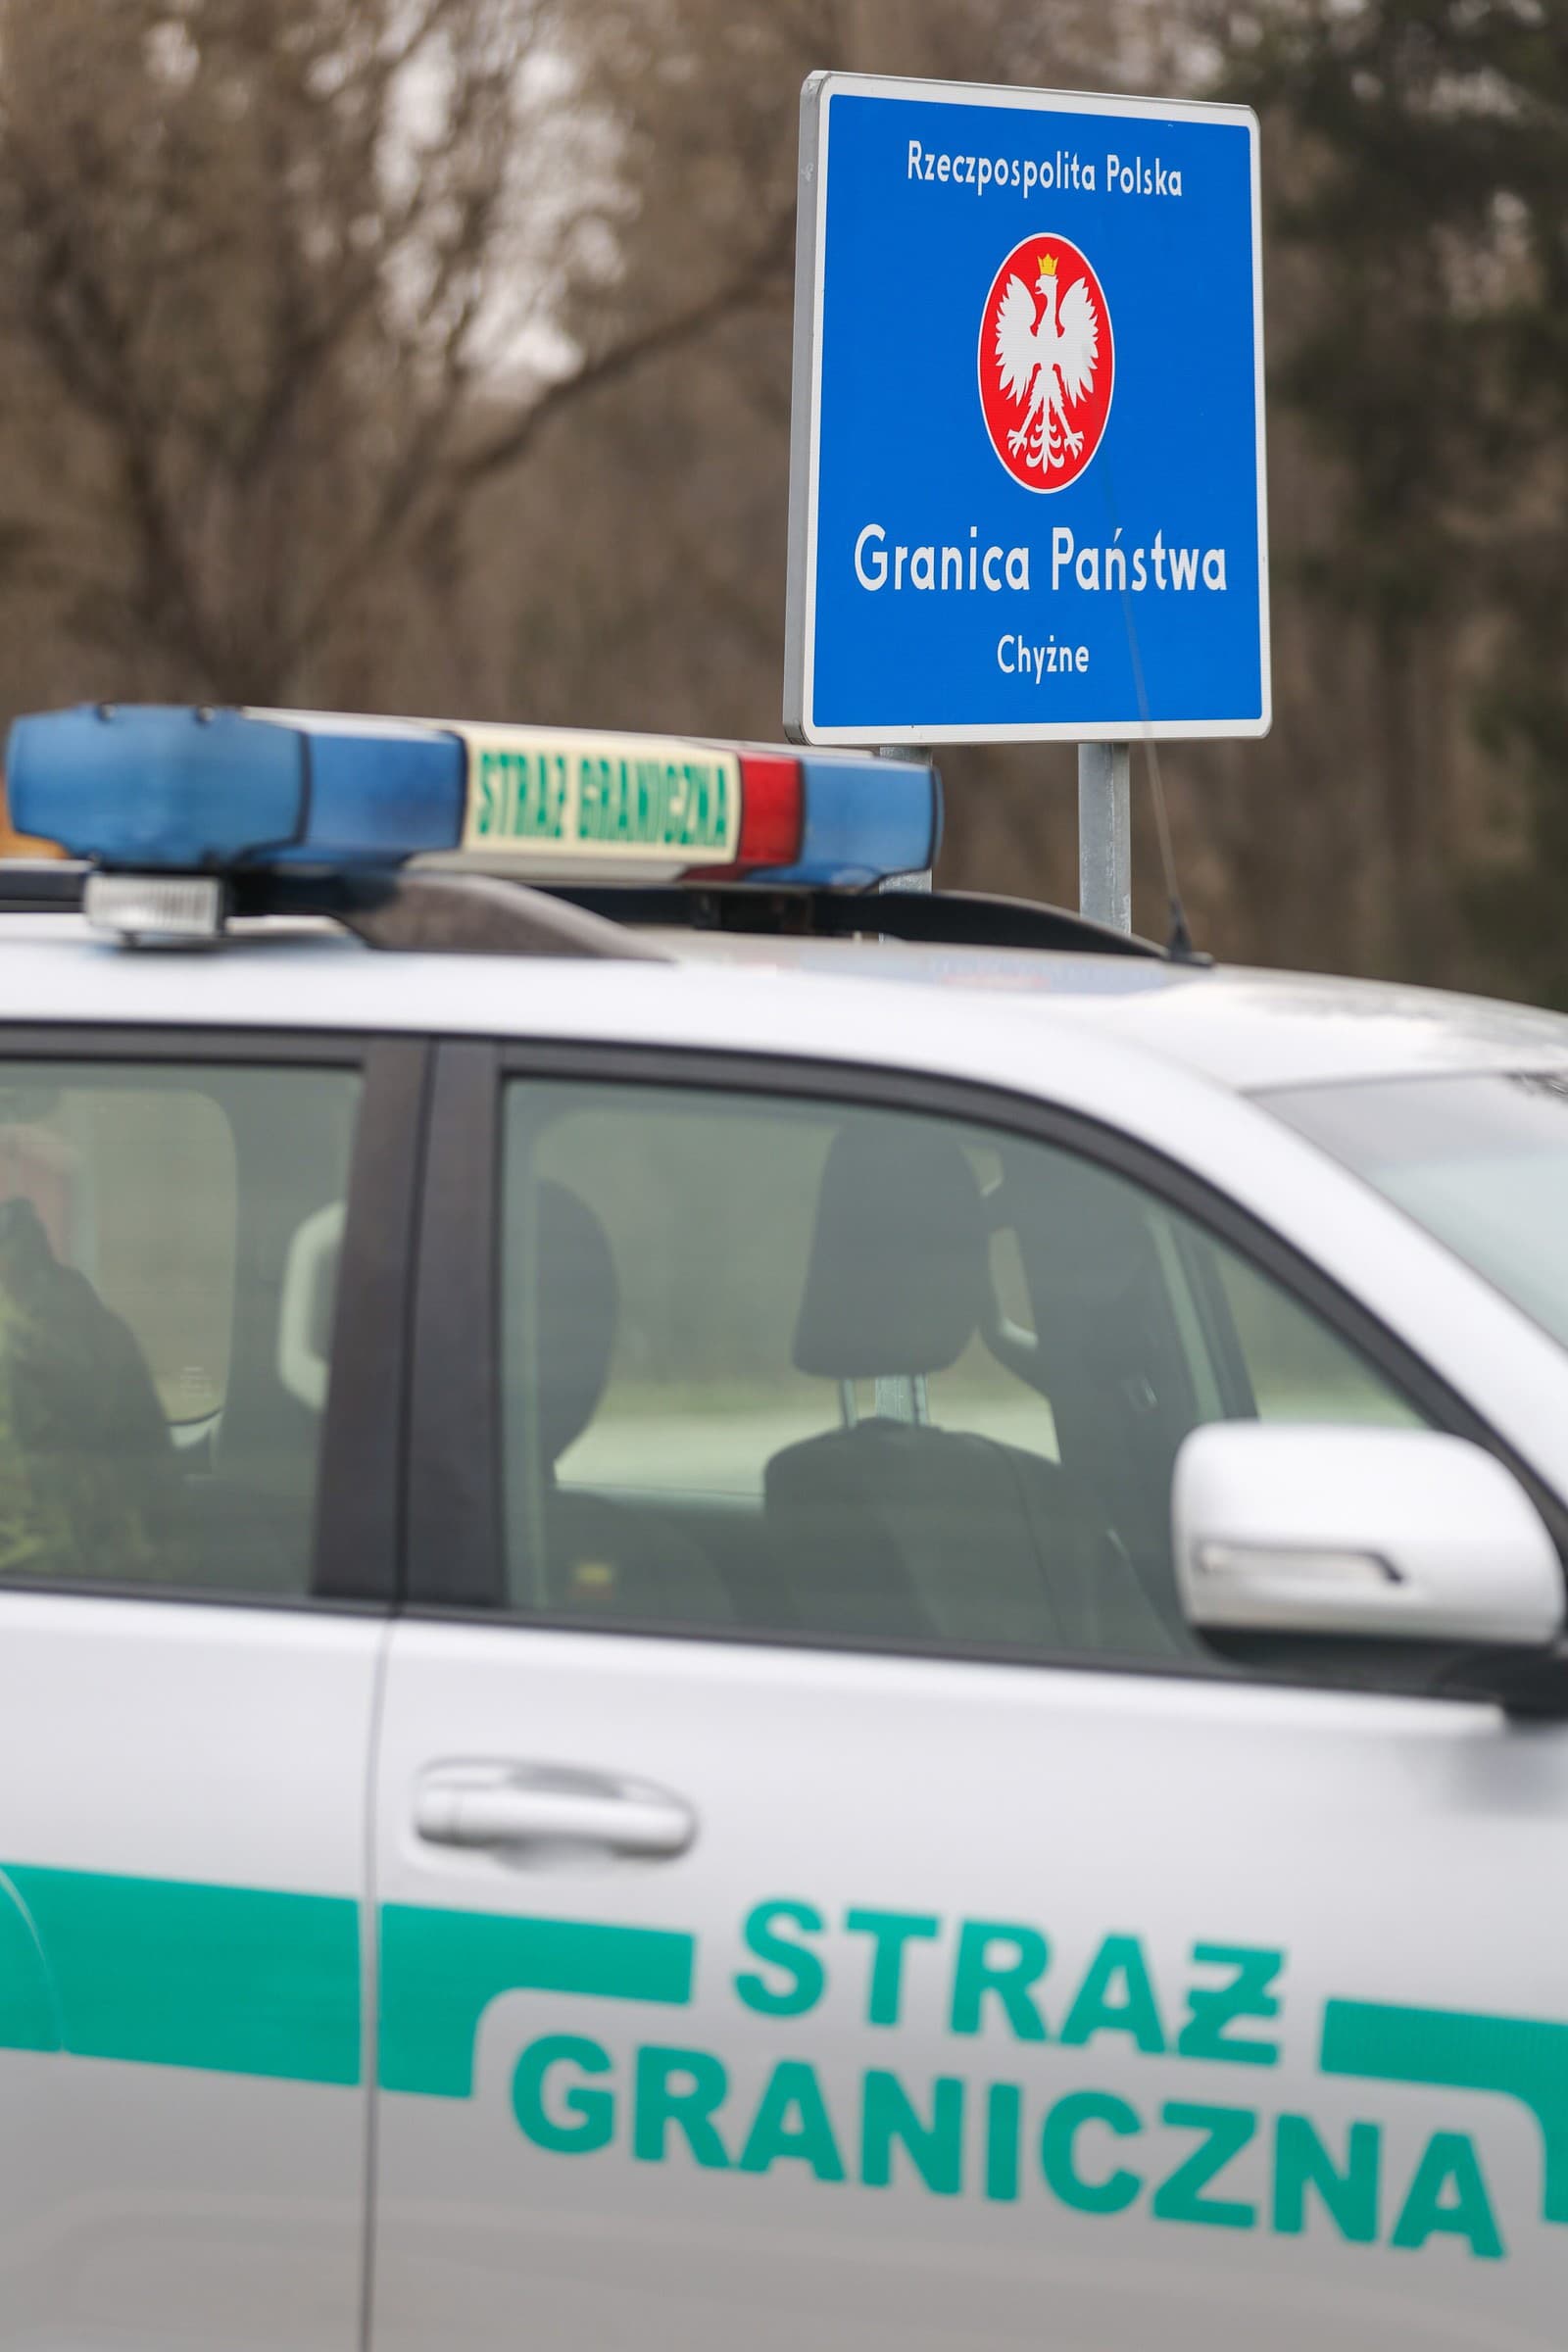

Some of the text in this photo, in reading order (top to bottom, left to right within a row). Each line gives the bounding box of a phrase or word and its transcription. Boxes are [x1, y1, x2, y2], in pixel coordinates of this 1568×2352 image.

[906, 139, 1184, 199] Rzeczpospolita Polska
[854, 523, 1228, 592] Granica Państwa
[997, 634, 1090, 685] Chyżne
[577, 758, 728, 847] GRANICZNA
[511, 2034, 1506, 2260] GRANICZNA
